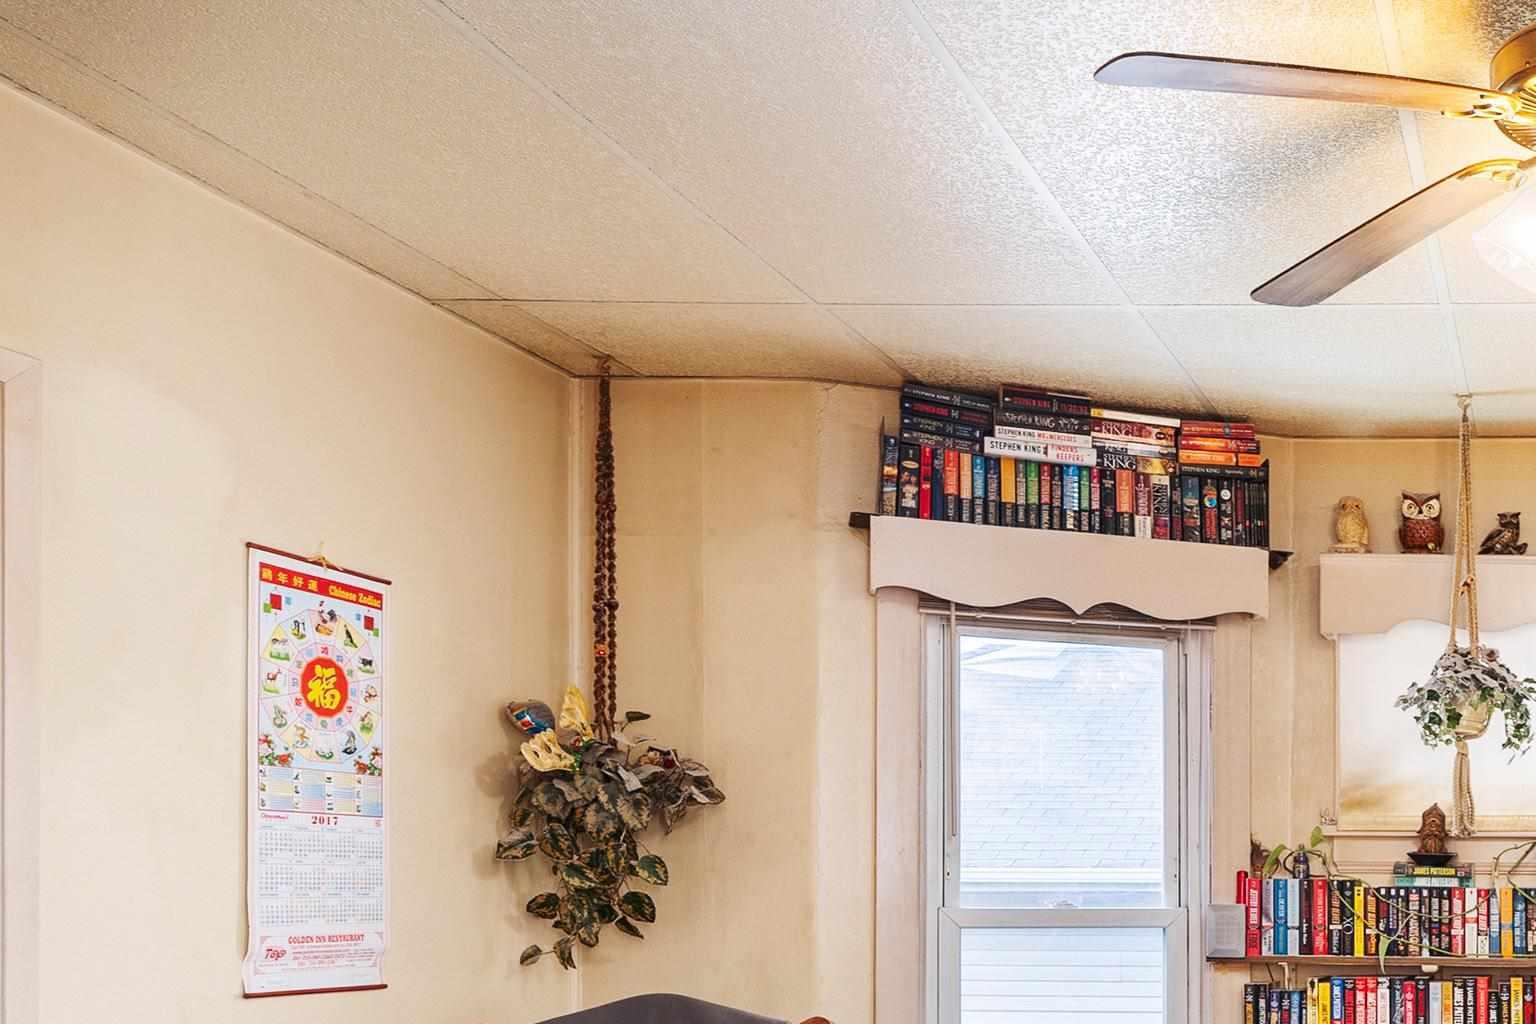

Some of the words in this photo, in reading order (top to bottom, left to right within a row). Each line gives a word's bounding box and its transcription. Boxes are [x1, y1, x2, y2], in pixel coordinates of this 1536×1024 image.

[990, 441, 1021, 451] STEPHEN
[1024, 445, 1041, 454] KING
[1103, 457, 1136, 470] KING
[328, 585, 357, 602] Chinese
[307, 664, 341, 710] 福
[312, 816, 338, 825] 2017
[288, 936, 314, 944] GOLDEN
[1454, 987, 1463, 1006] JAMES
